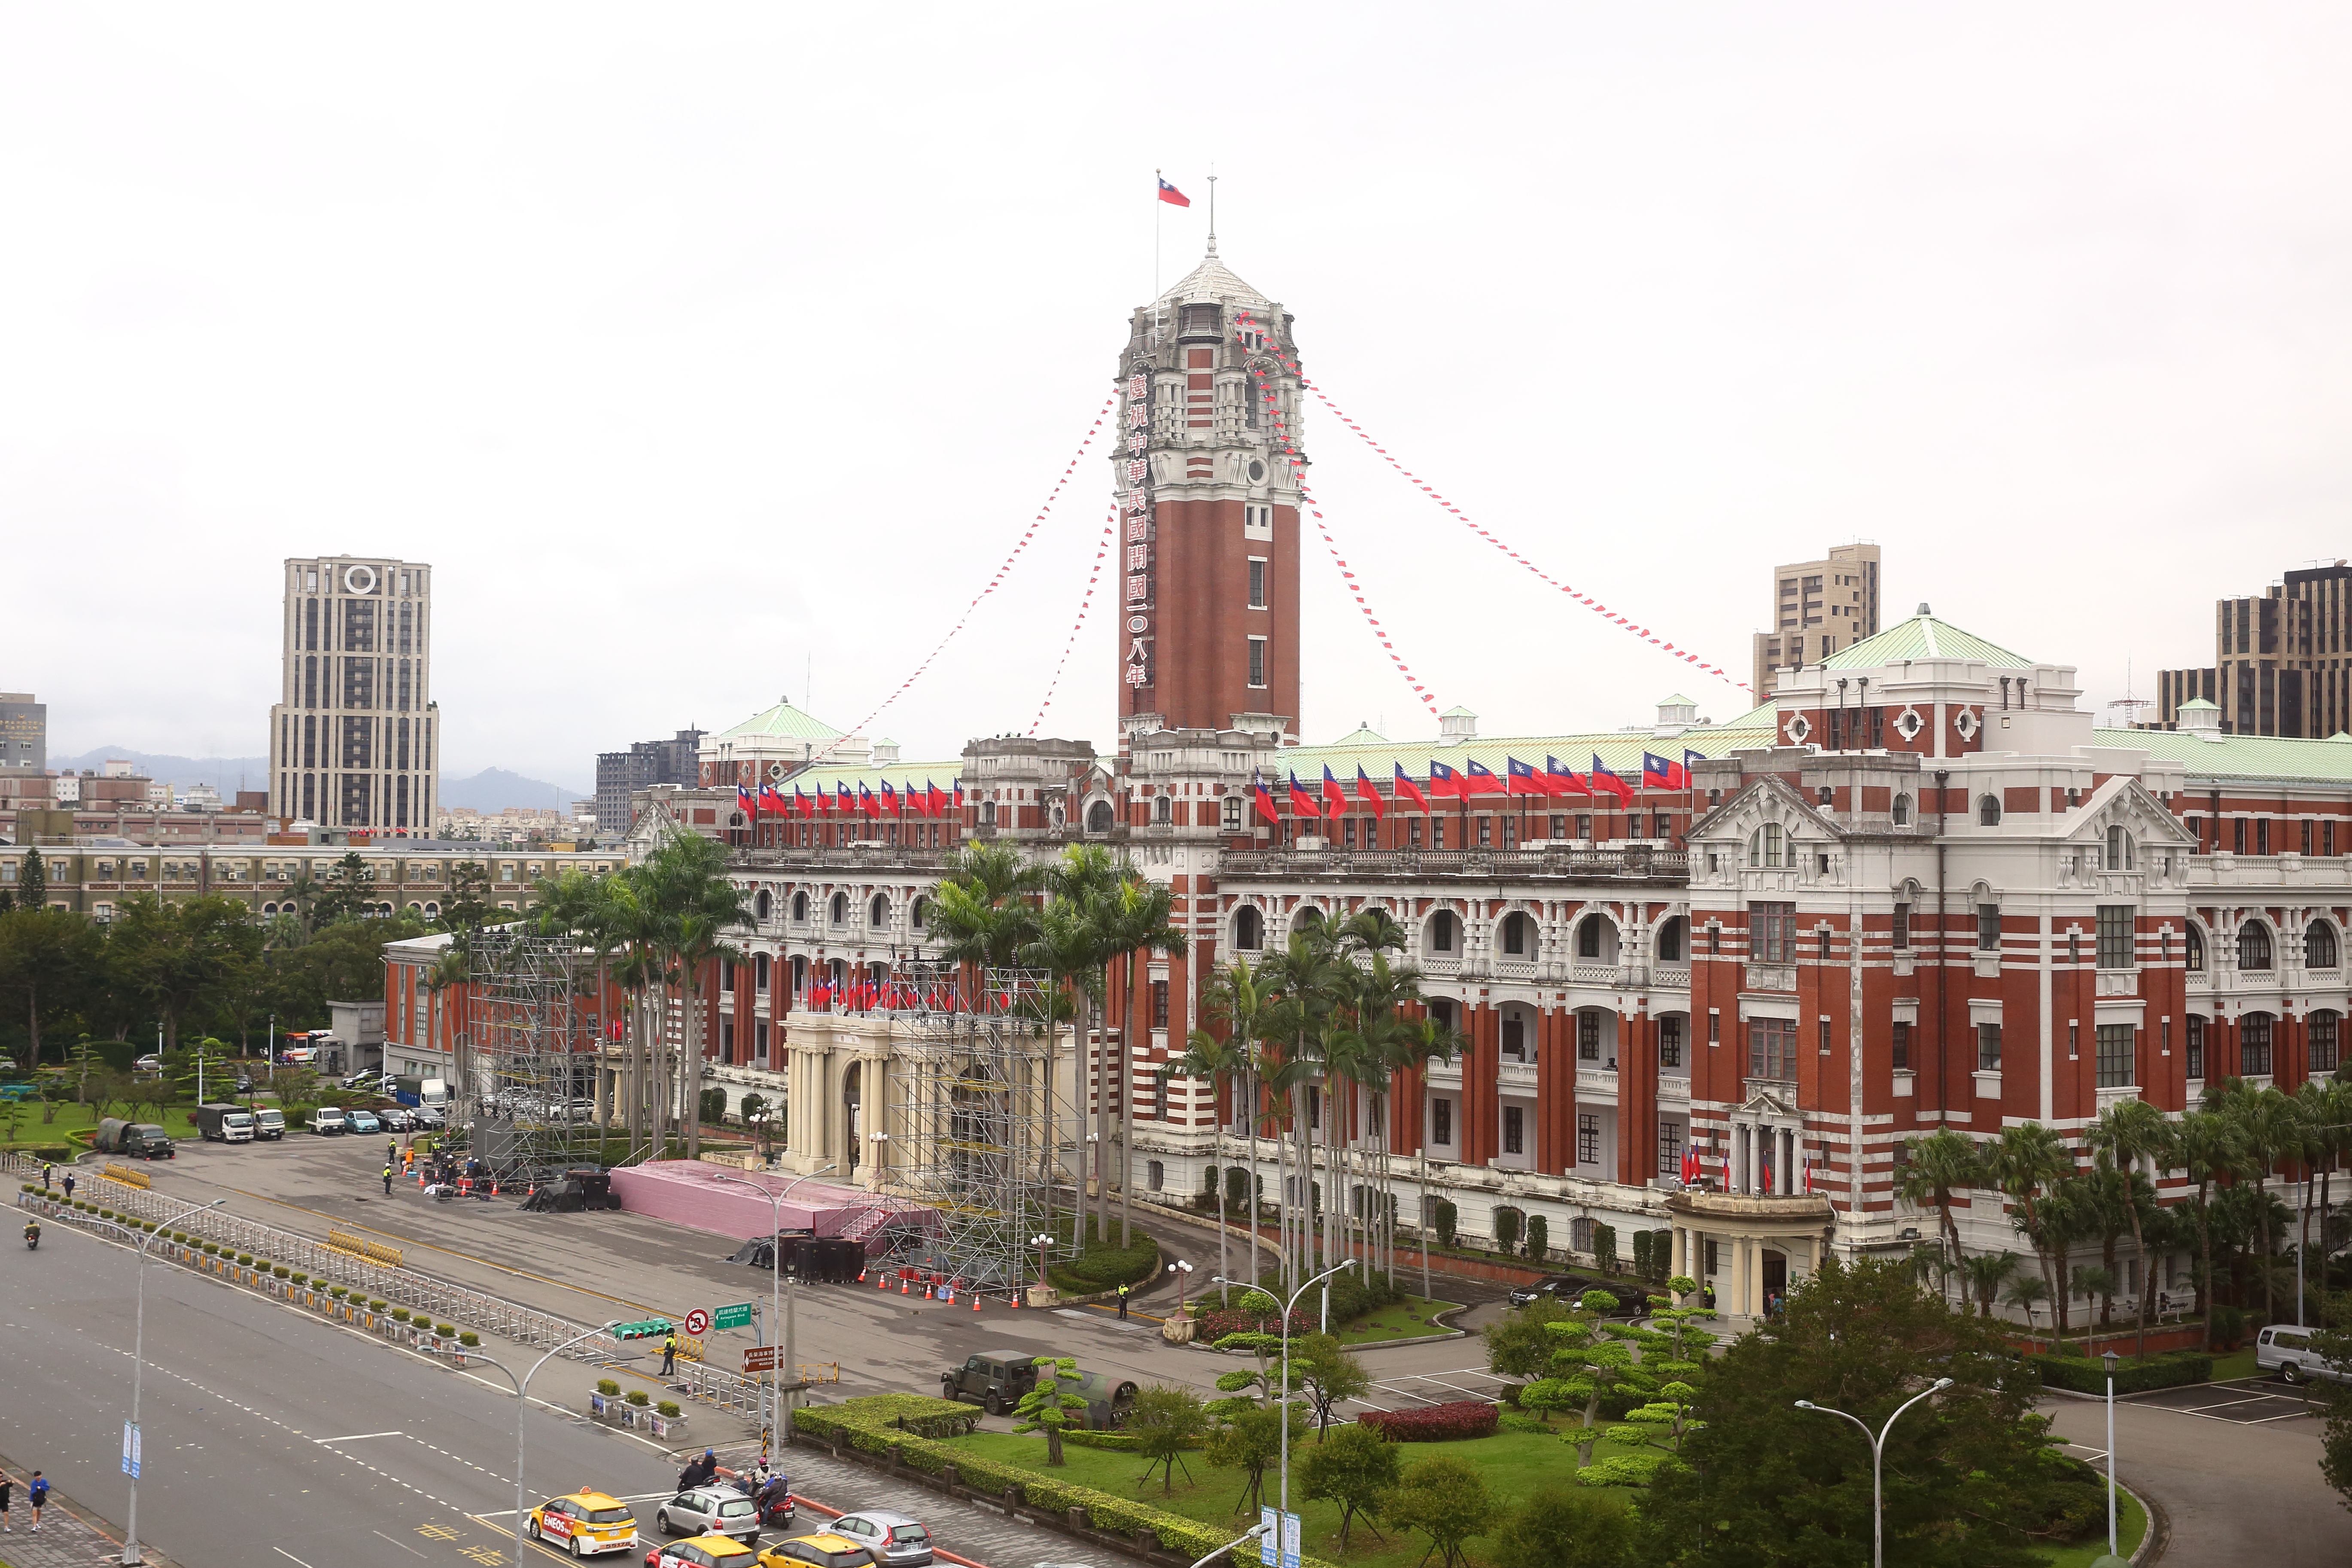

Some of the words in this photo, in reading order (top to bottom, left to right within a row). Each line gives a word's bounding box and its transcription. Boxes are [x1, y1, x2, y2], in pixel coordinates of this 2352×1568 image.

[749, 1349, 783, 1358] 長榮海事博館
[544, 1514, 565, 1532] ENEOS
[1263, 1549, 1275, 1557] 1/11-14
